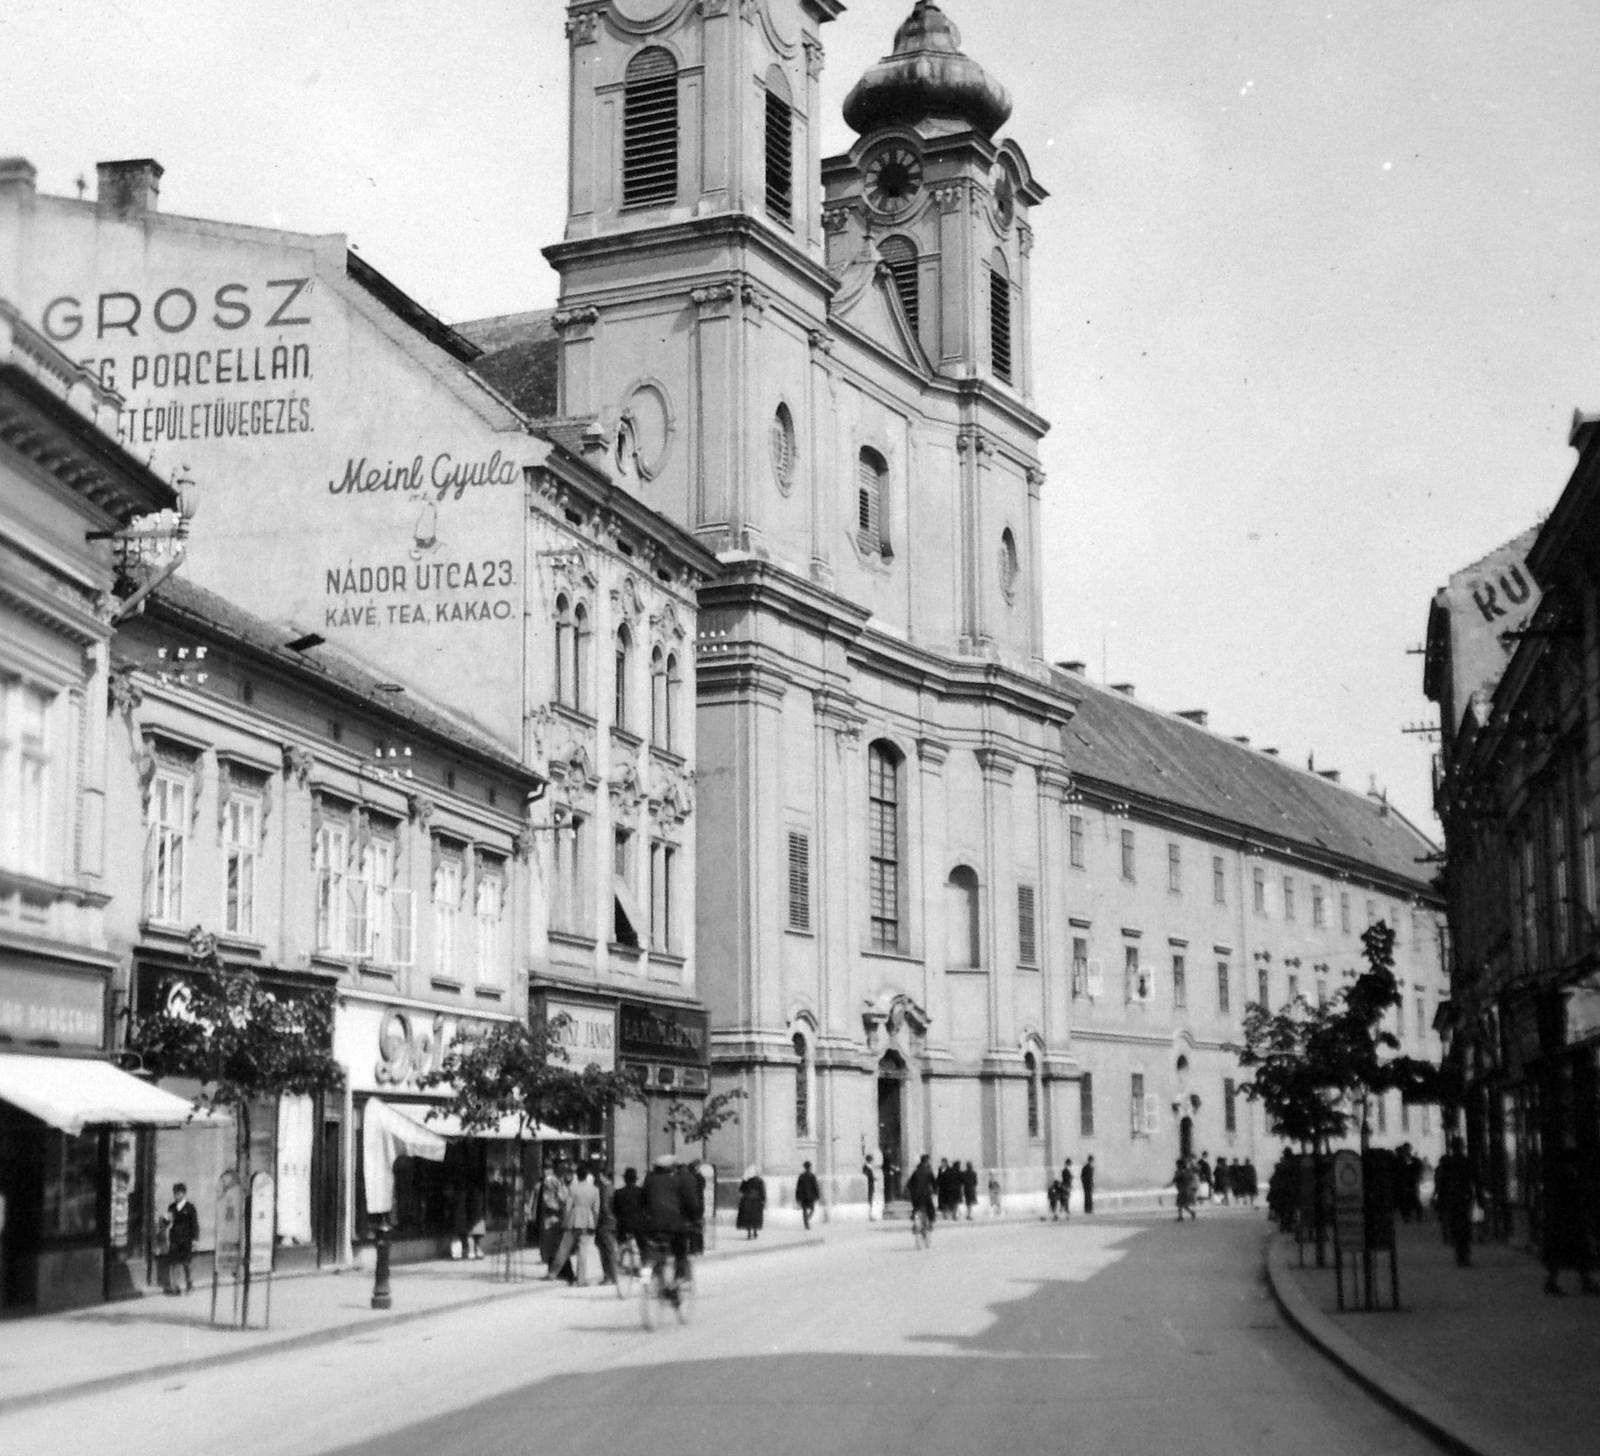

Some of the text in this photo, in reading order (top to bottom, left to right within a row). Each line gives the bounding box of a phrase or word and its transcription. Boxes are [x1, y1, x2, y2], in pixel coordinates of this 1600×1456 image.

[42, 277, 312, 342] GROSZ
[328, 449, 520, 501] Meinl Gyula
[326, 558, 407, 595] NÁDOR
[416, 561, 478, 591] UTCA
